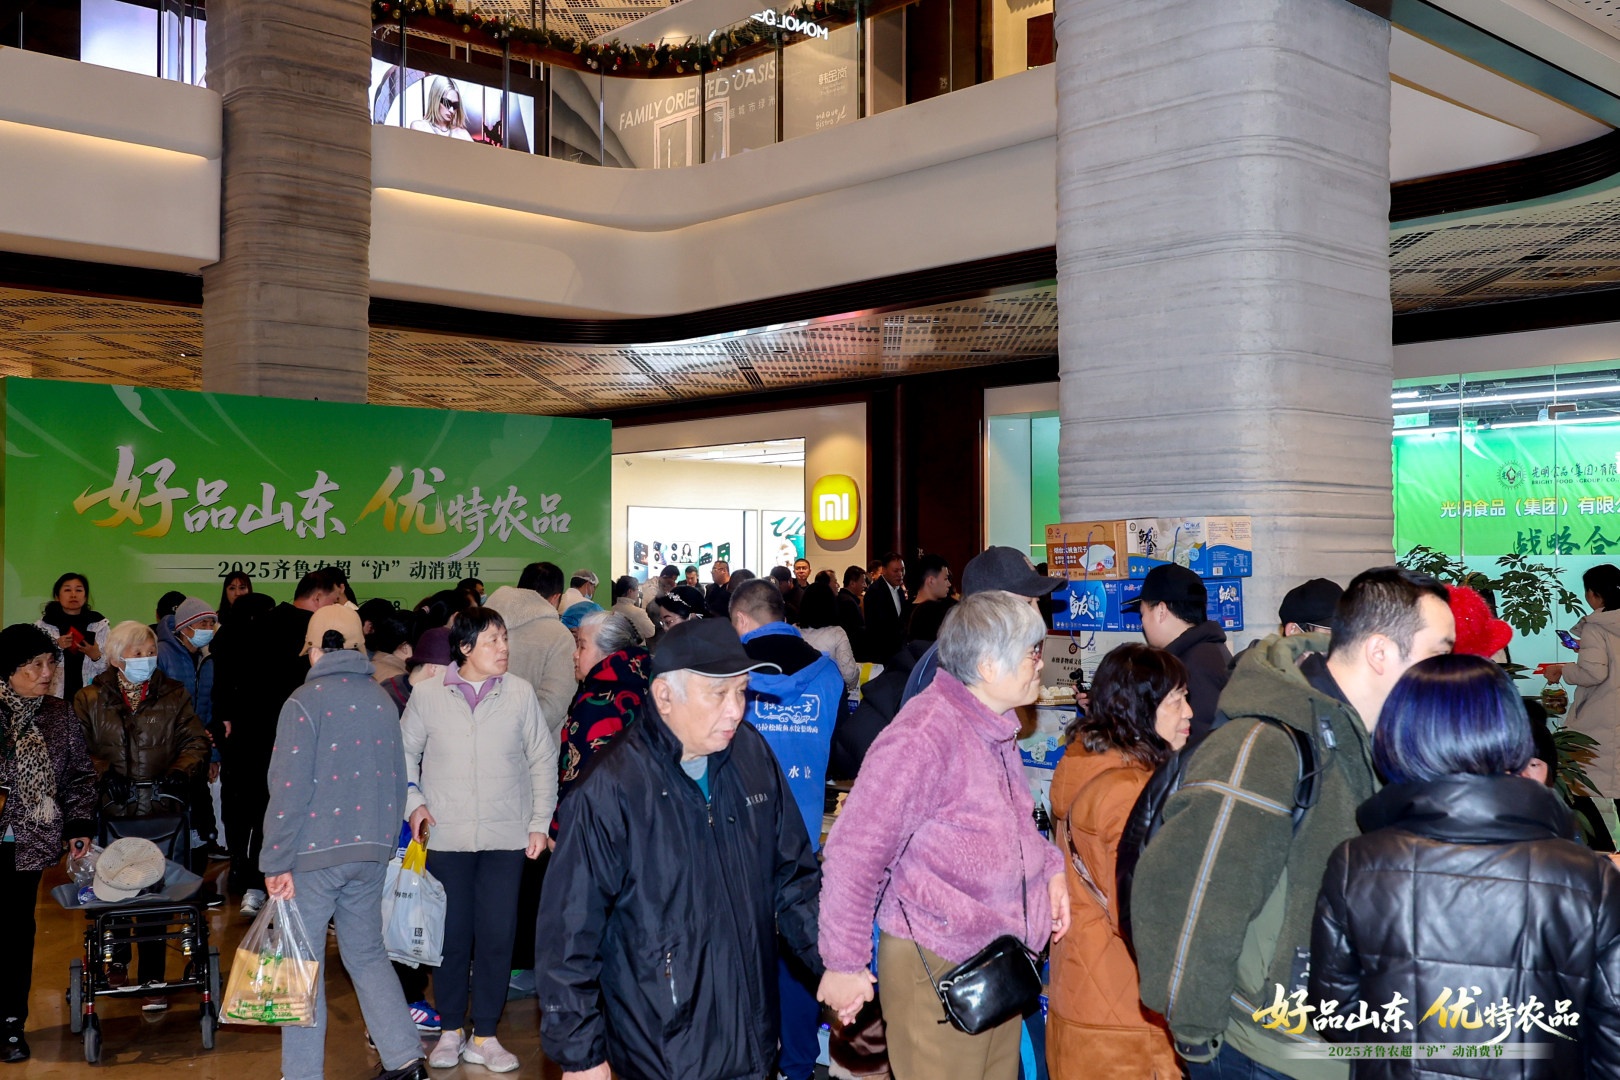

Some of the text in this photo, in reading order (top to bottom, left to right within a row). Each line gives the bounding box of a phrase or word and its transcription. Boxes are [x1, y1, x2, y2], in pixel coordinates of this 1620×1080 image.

[619, 99, 662, 131] FAMILY
[733, 60, 776, 91] OASIS
[73, 445, 571, 560] 好品山东 优特农品
[1513, 525, 1620, 555] 战略合
